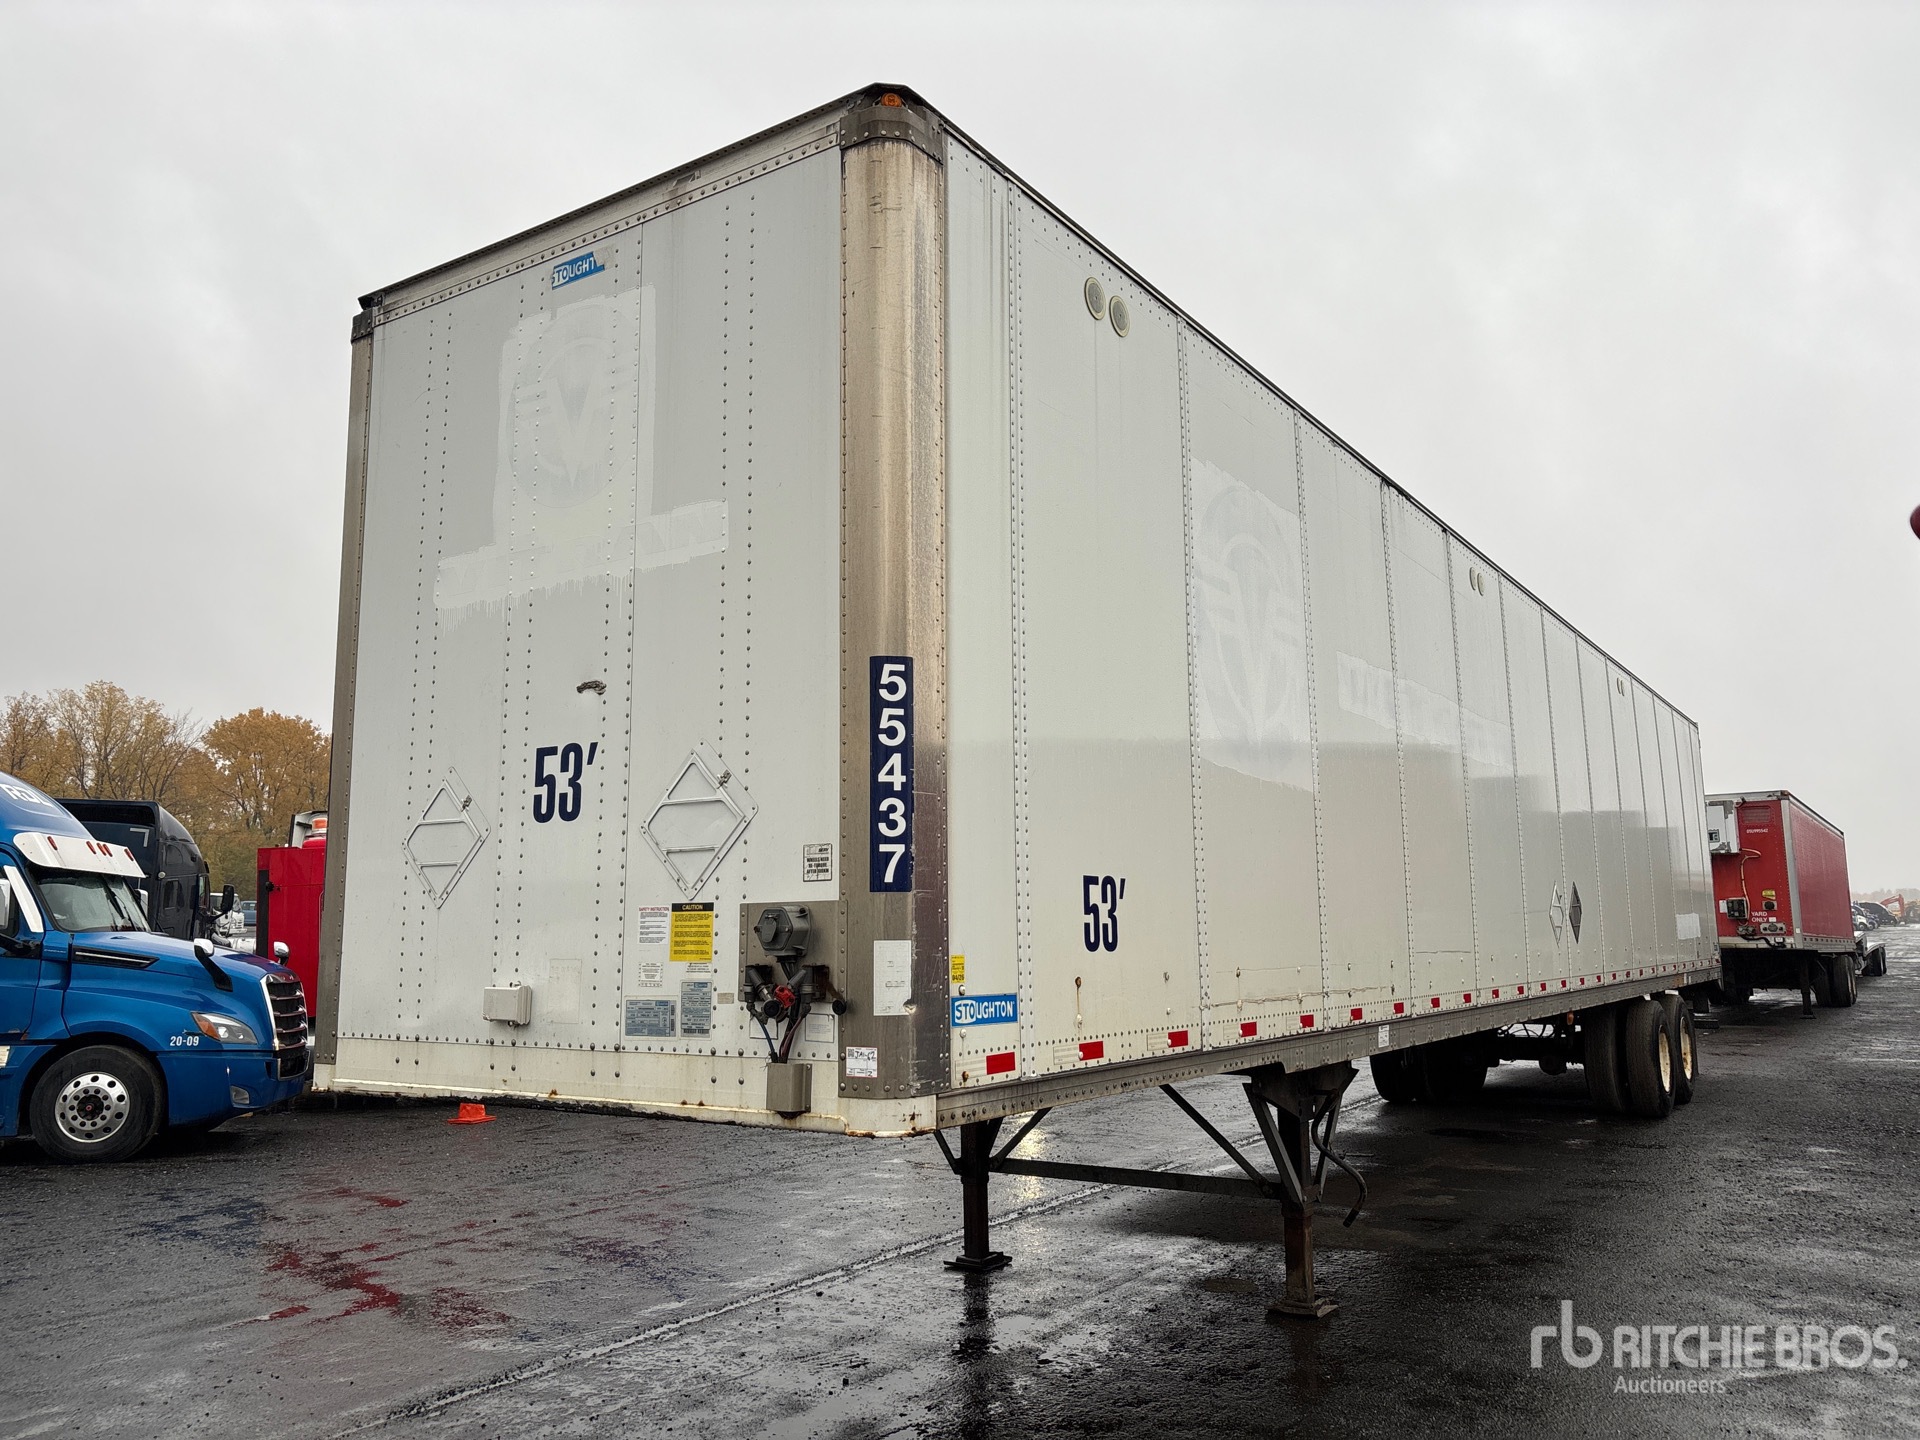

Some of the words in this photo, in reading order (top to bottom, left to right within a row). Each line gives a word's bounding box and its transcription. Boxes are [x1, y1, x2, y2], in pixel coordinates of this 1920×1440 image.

[552, 256, 596, 287] TOUGHT
[533, 742, 598, 824] 53'
[877, 663, 907, 883] 55437
[1083, 875, 1126, 952] 53'
[955, 1000, 1014, 1021] STOUGHTON
[169, 1035, 200, 1046] 20-09
